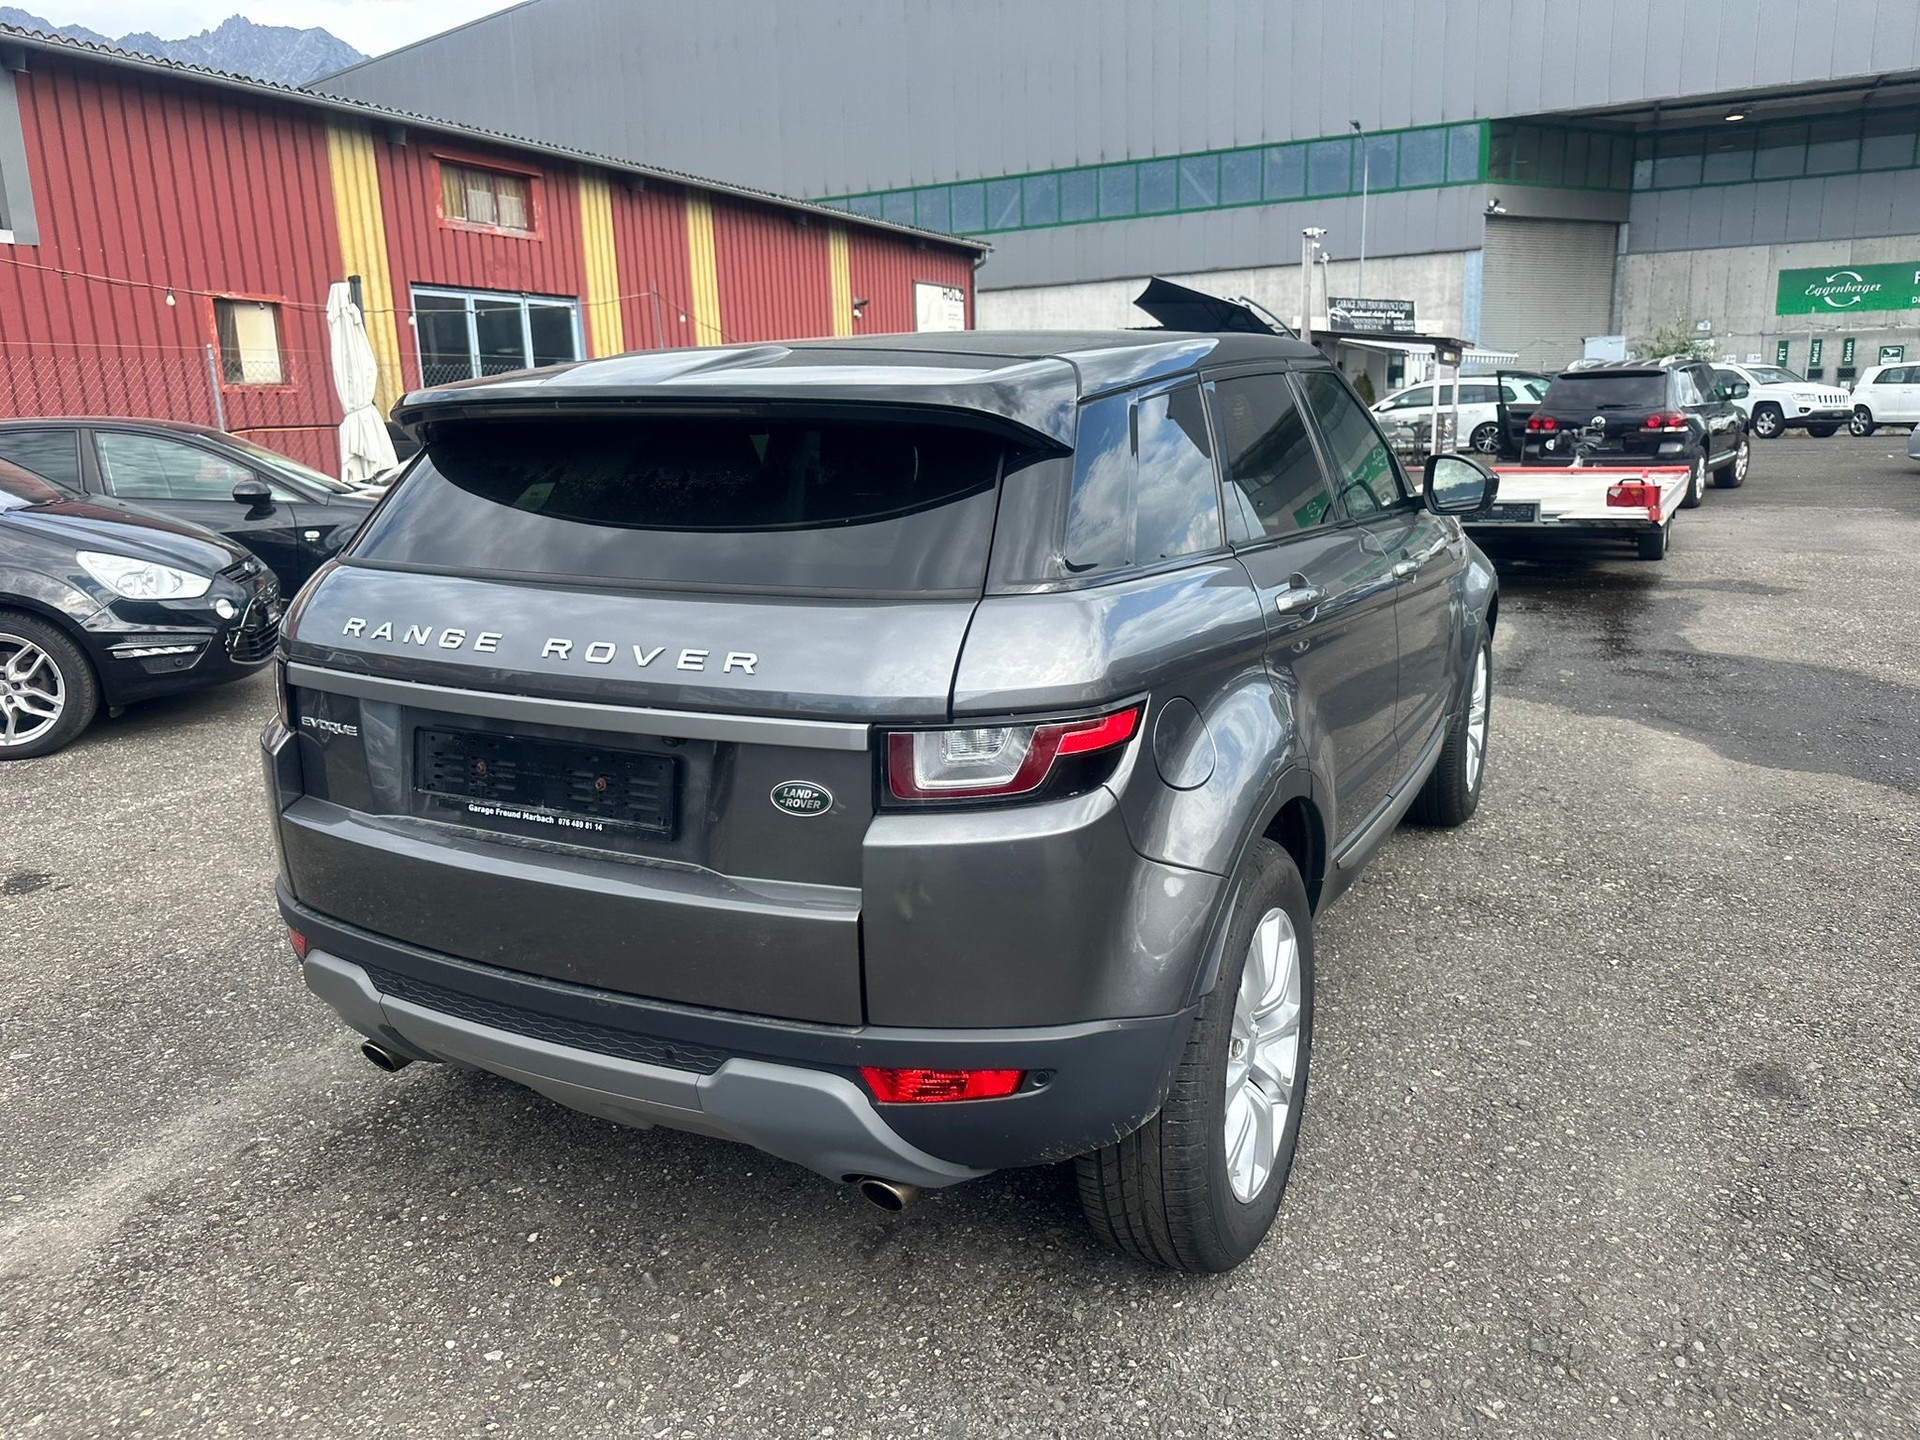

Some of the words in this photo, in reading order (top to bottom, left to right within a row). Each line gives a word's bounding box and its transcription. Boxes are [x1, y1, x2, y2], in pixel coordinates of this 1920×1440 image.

[942, 287, 964, 302] HOLZ
[1805, 282, 1882, 297] Eggenberger
[1812, 343, 1820, 363] Metall
[1844, 342, 1853, 362] Dosen
[342, 616, 503, 653] RANGE
[541, 637, 760, 676] ROVER
[301, 716, 358, 736] EVOQUE
[468, 804, 494, 815] Garage
[496, 808, 521, 819] Freund
[523, 812, 554, 824] Marbach
[558, 818, 570, 826] 076
[571, 820, 584, 829] 489
[584, 822, 593, 830] 81
[594, 824, 603, 832] 14
